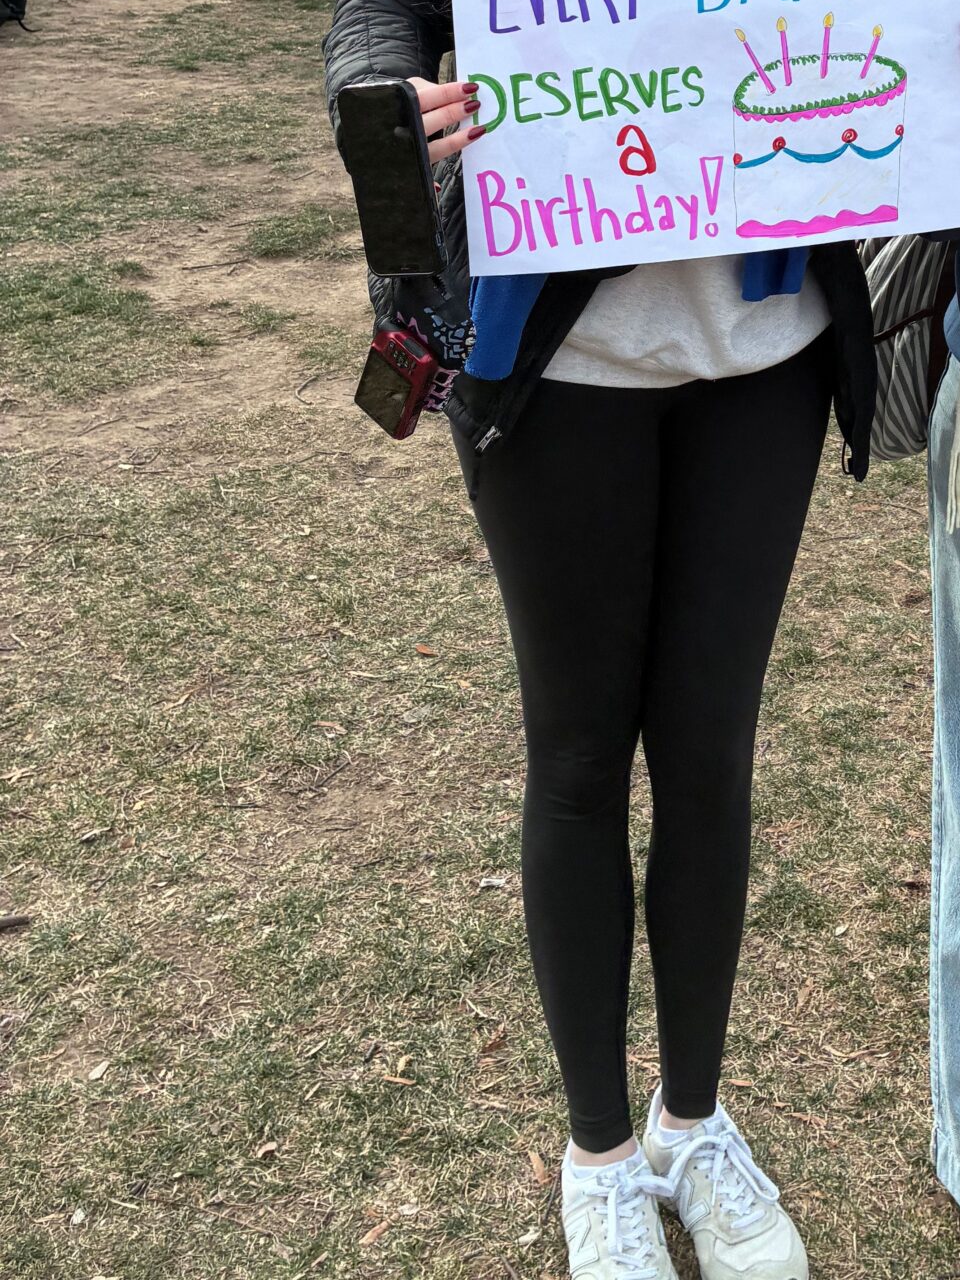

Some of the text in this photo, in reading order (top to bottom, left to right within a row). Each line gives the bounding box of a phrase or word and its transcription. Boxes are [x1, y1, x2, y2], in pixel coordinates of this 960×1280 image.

[467, 65, 706, 133] DESERVES
[615, 124, 657, 177] a
[477, 156, 724, 258] Birthday!
